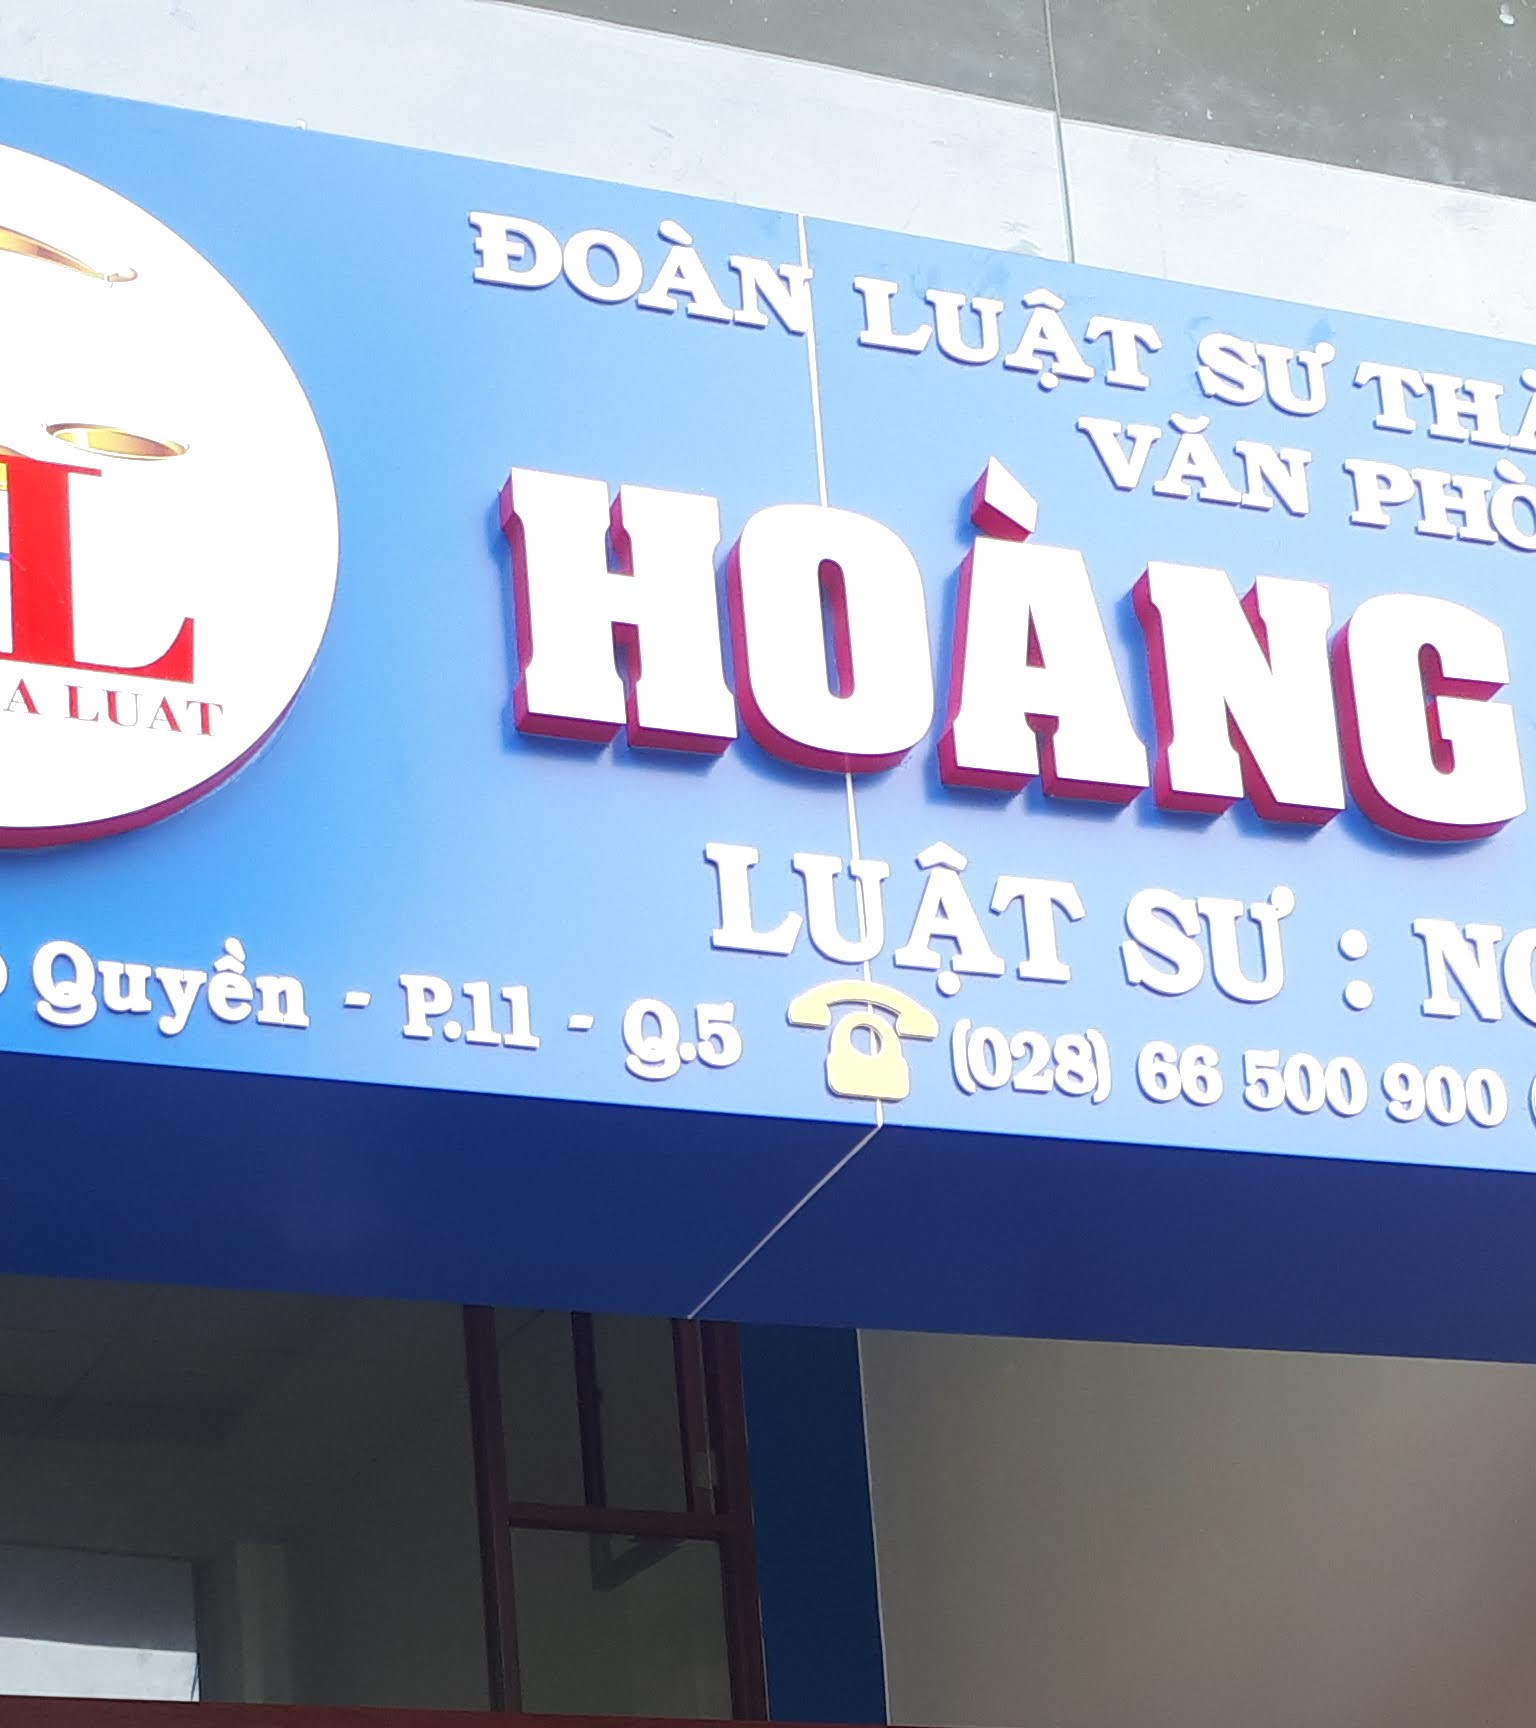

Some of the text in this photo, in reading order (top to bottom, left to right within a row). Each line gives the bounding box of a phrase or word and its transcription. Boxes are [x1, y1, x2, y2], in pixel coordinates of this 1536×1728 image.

[469, 211, 812, 336] ĐOÀN
[854, 275, 1162, 392] LUẬT
[1196, 332, 1336, 416] SƯ
[1078, 414, 1312, 516] VĂN
[64, 684, 223, 737] LUAT
[497, 455, 1529, 843] HOÀNG
[704, 839, 1086, 999] LUẬT
[1121, 885, 1296, 1003] SƯ
[31, 937, 310, 1036] Quyền
[398, 974, 540, 1050] P.11
[622, 999, 742, 1081] Q.5
[953, 1018, 1508, 1128] (028) 66 500 900
